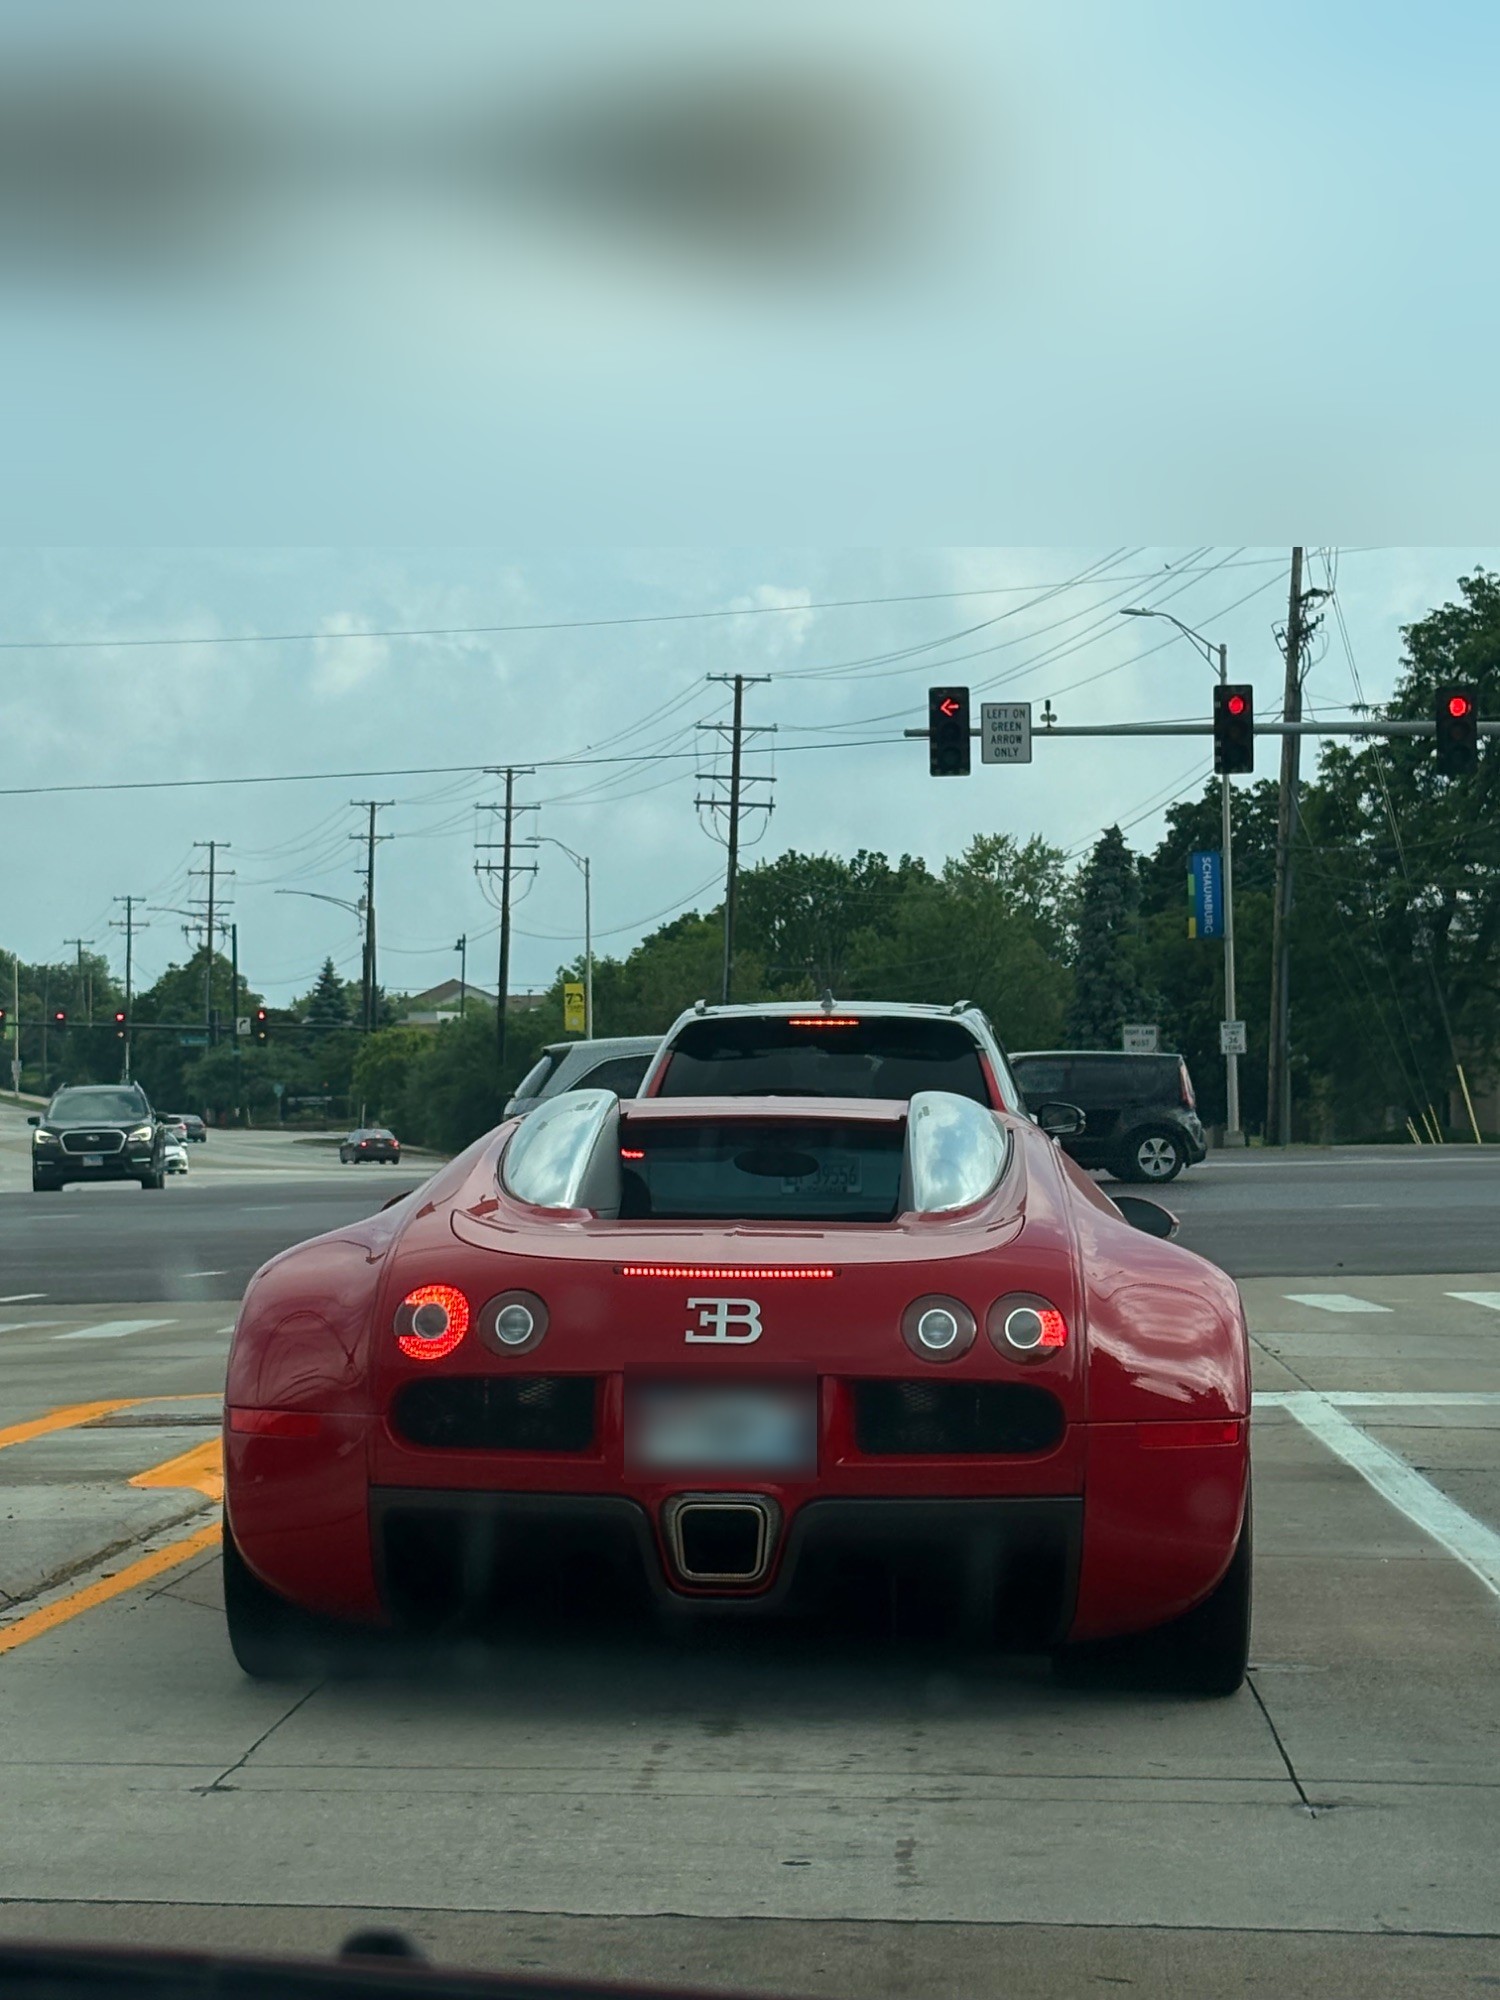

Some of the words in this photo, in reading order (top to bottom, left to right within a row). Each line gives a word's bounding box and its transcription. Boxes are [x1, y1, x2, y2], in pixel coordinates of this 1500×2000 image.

[987, 708, 1007, 719] LEFT
[1013, 708, 1026, 719] ON
[991, 721, 1022, 732] GREEN
[991, 734, 1022, 744] ARROW
[994, 747, 1019, 757] ONLY
[1201, 856, 1214, 934] SCHAUMBURG
